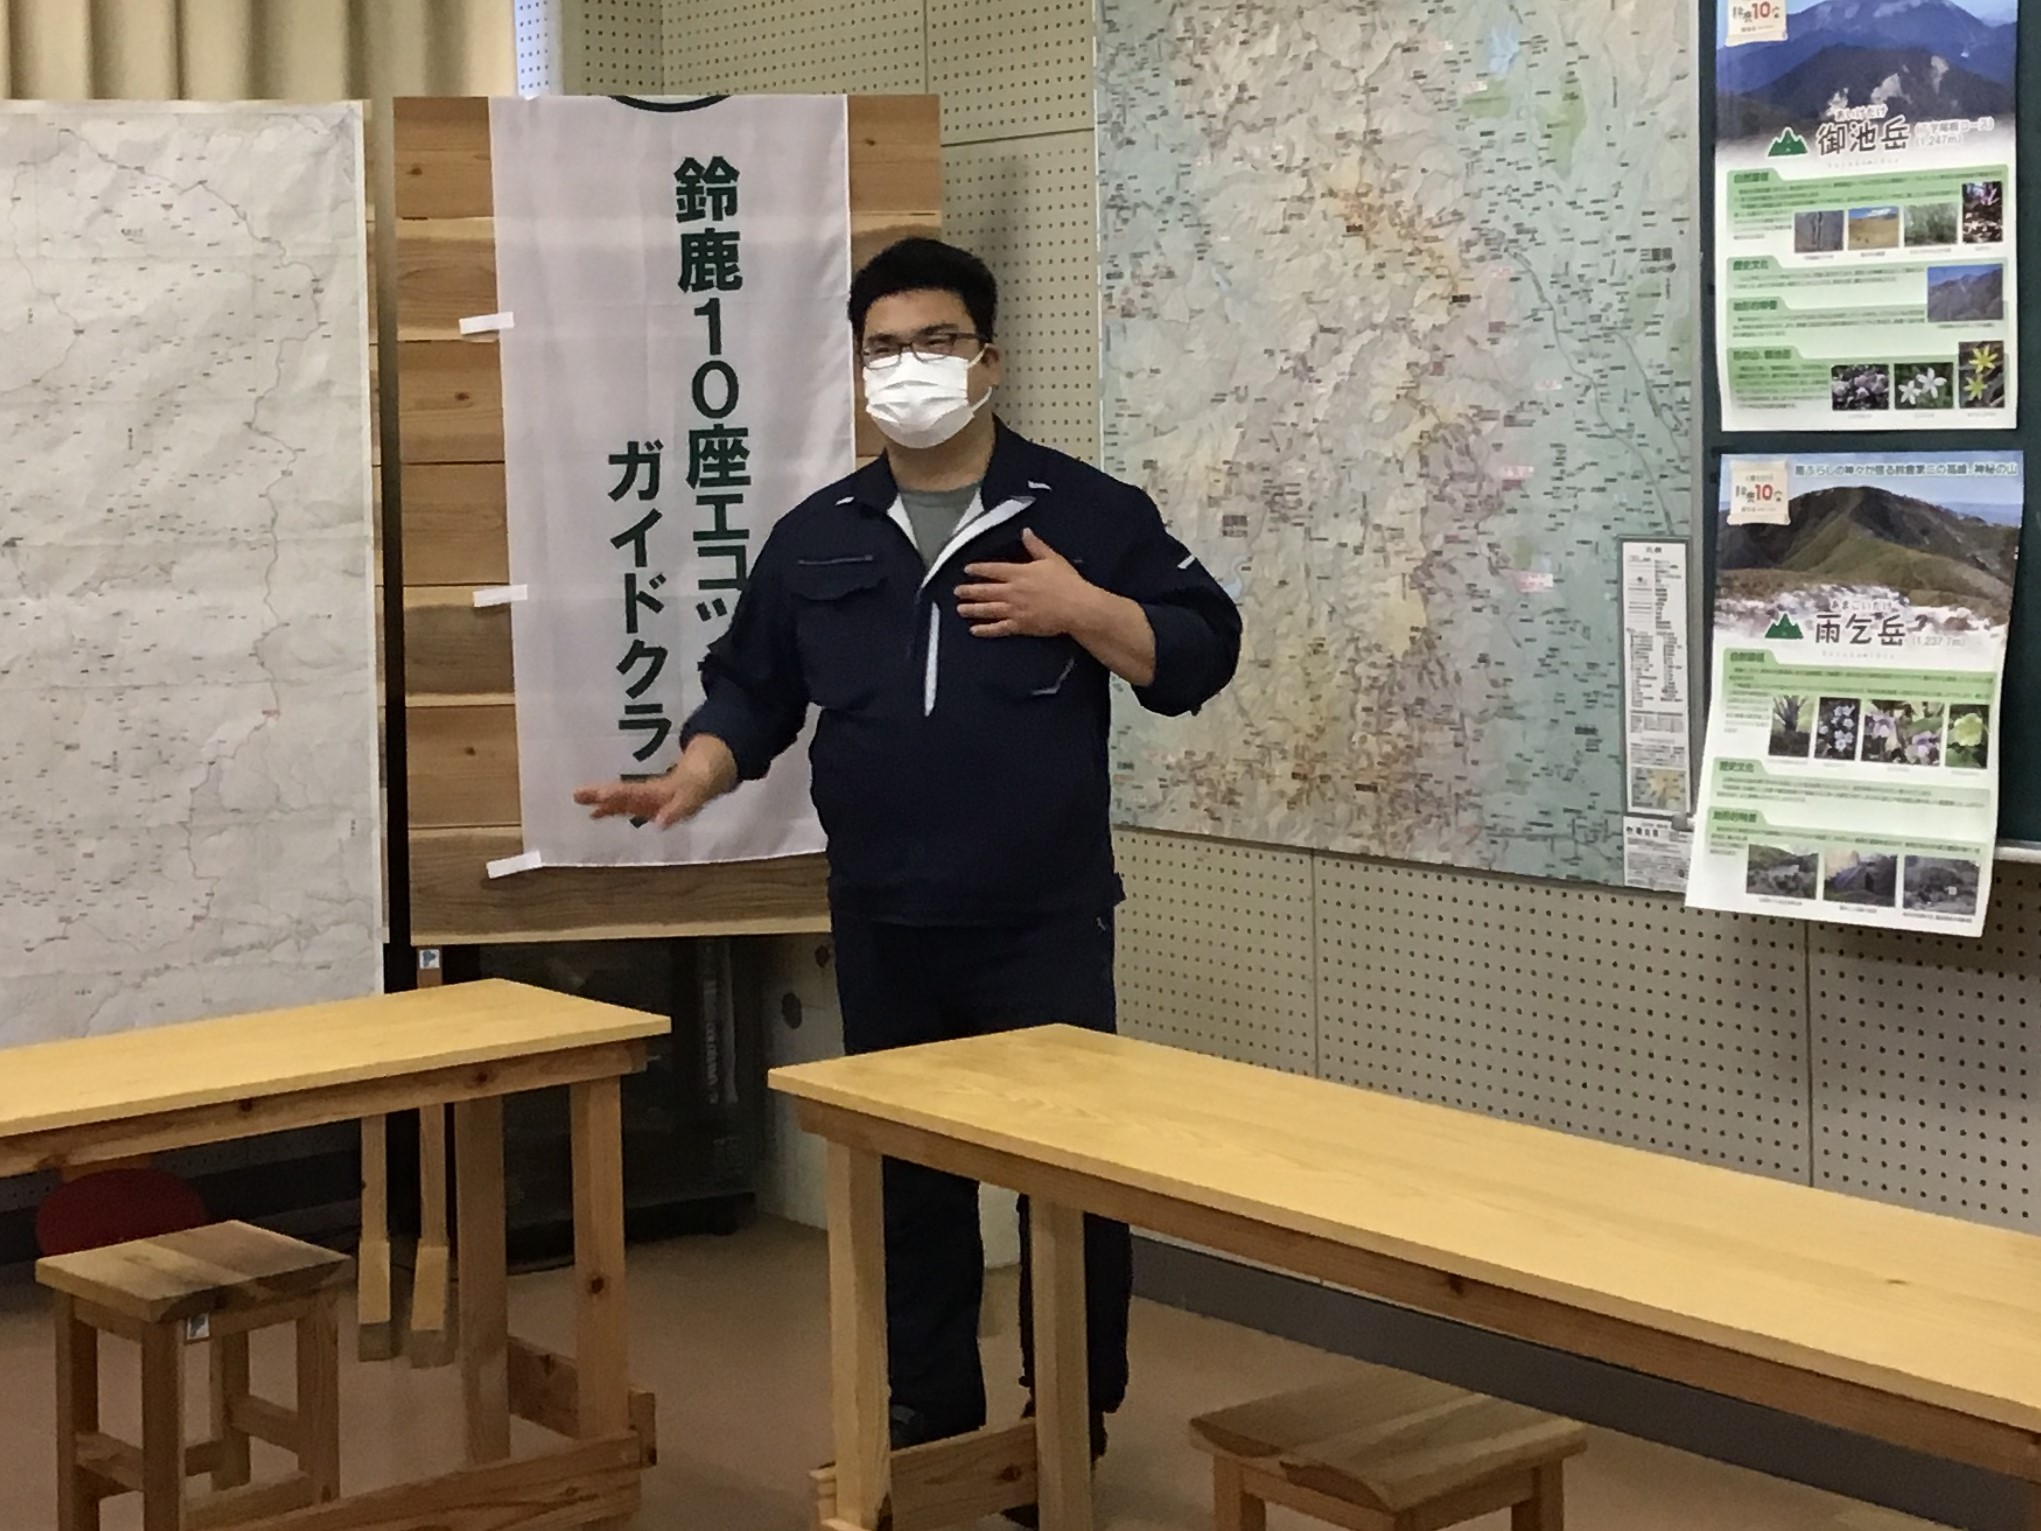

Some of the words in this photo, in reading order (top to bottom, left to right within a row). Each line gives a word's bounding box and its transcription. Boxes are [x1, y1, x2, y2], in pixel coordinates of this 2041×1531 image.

[1817, 116, 1909, 156] 御池岳
[1815, 613, 1906, 646] 雨乞岳
